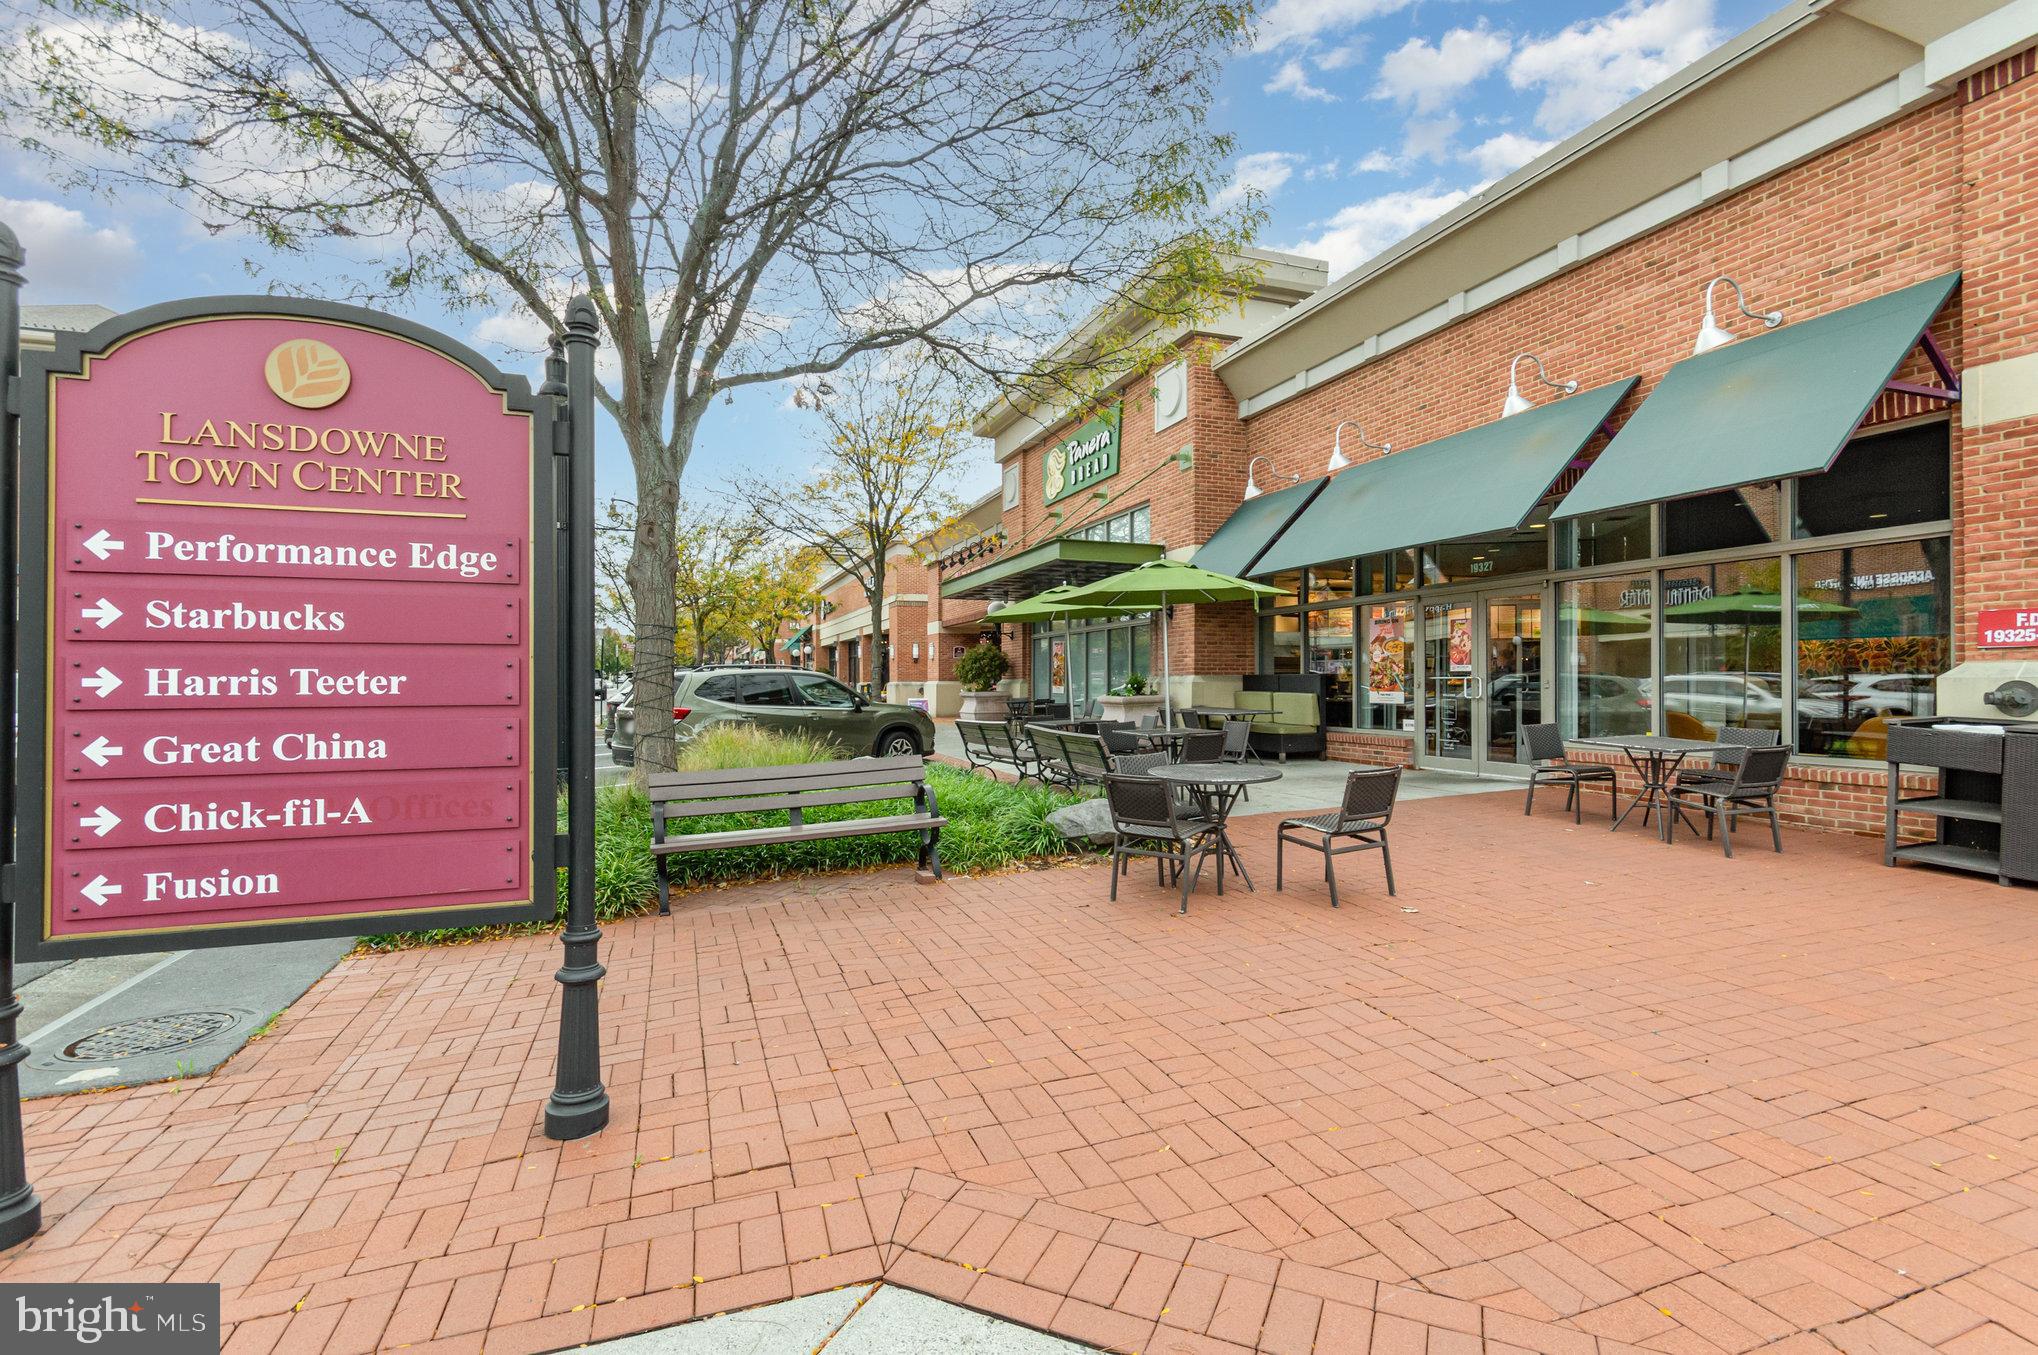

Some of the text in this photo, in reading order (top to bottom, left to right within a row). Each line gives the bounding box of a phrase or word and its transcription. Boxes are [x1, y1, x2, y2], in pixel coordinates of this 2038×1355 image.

[159, 411, 449, 463] LANSDOWNE
[1067, 430, 1111, 466] Panera
[135, 450, 467, 500] TOWN CENTER
[1070, 453, 1109, 486] BREAD
[145, 531, 498, 579] Performance Edge
[1470, 560, 1494, 573] 19327
[145, 599, 346, 632] Starbucks
[143, 667, 408, 697] Harris Teeter
[142, 731, 388, 766] Great China
[143, 796, 373, 833] Chick-fil-A
[369, 793, 496, 822] Offices
[142, 868, 280, 902] Fusion
